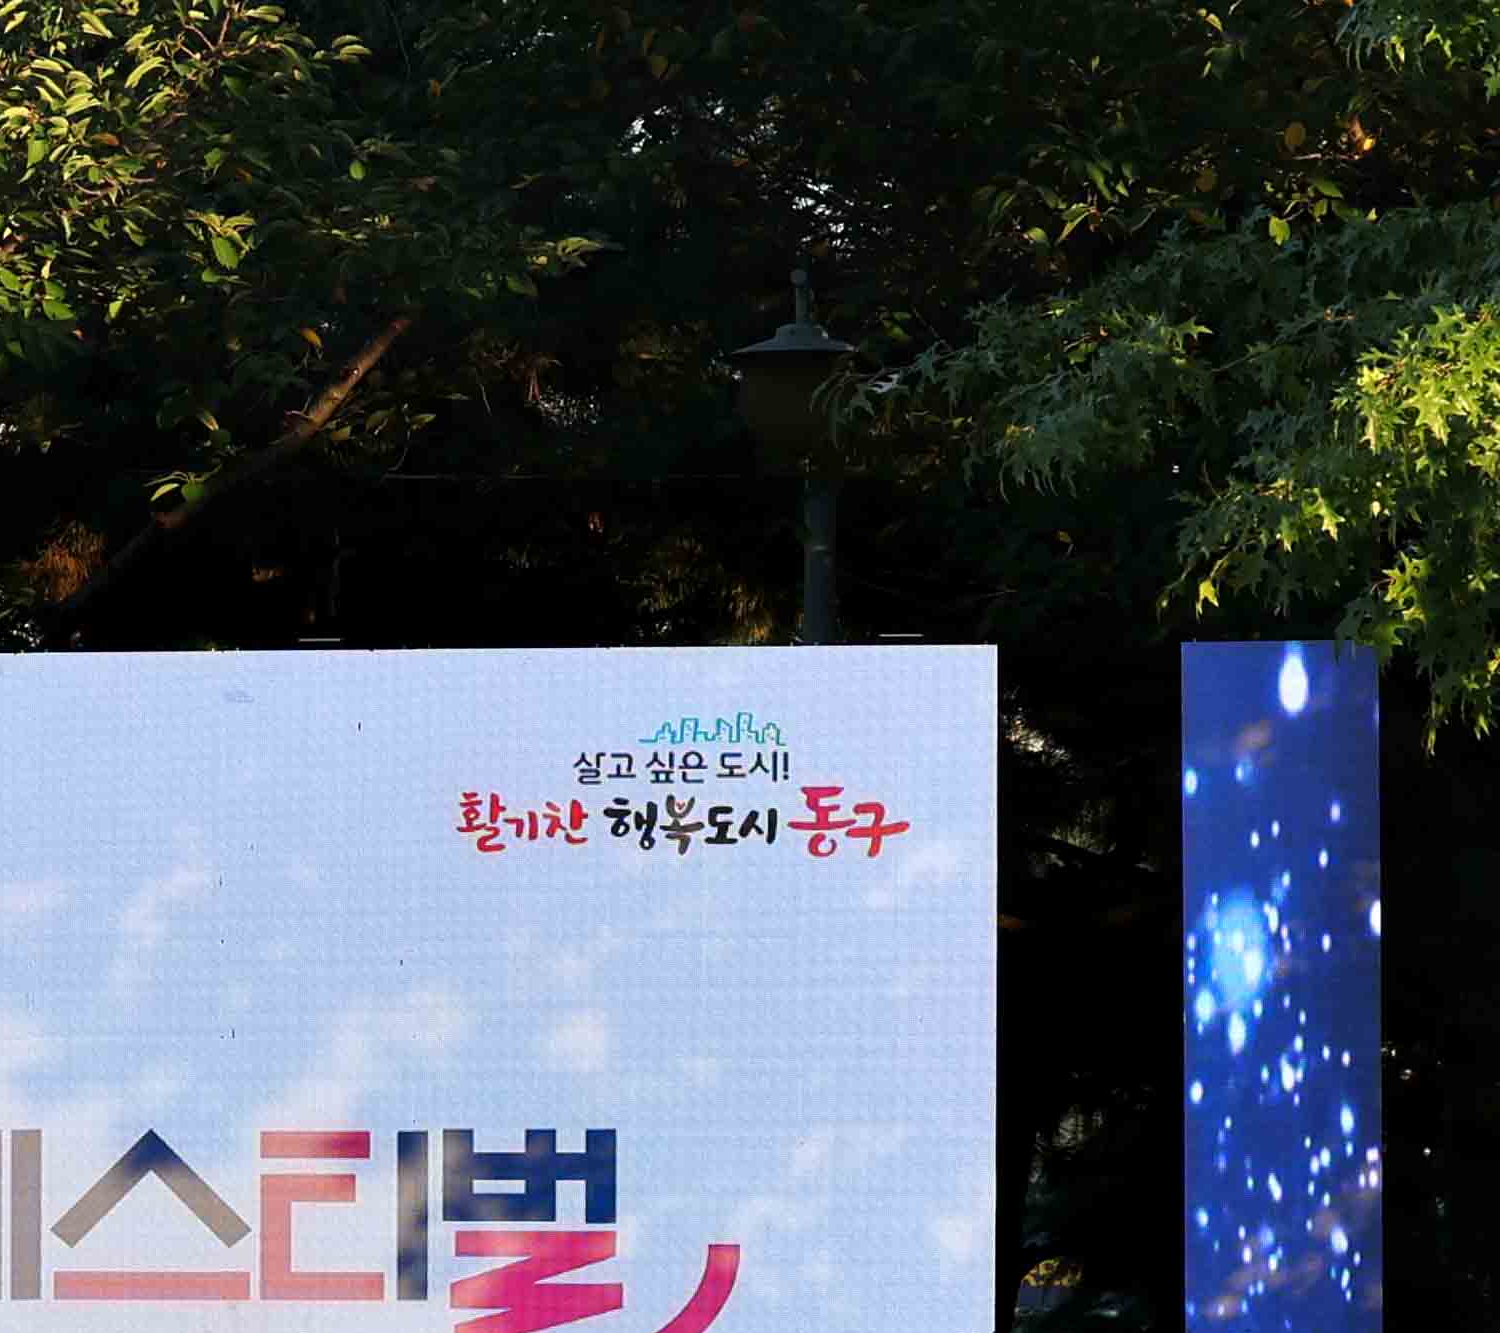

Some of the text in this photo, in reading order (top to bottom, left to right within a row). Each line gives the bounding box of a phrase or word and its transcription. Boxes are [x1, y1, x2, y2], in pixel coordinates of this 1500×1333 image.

[573, 751, 789, 783] 살고 싶은 도시!
[457, 786, 910, 856] 활기찬 행복도시 동구
